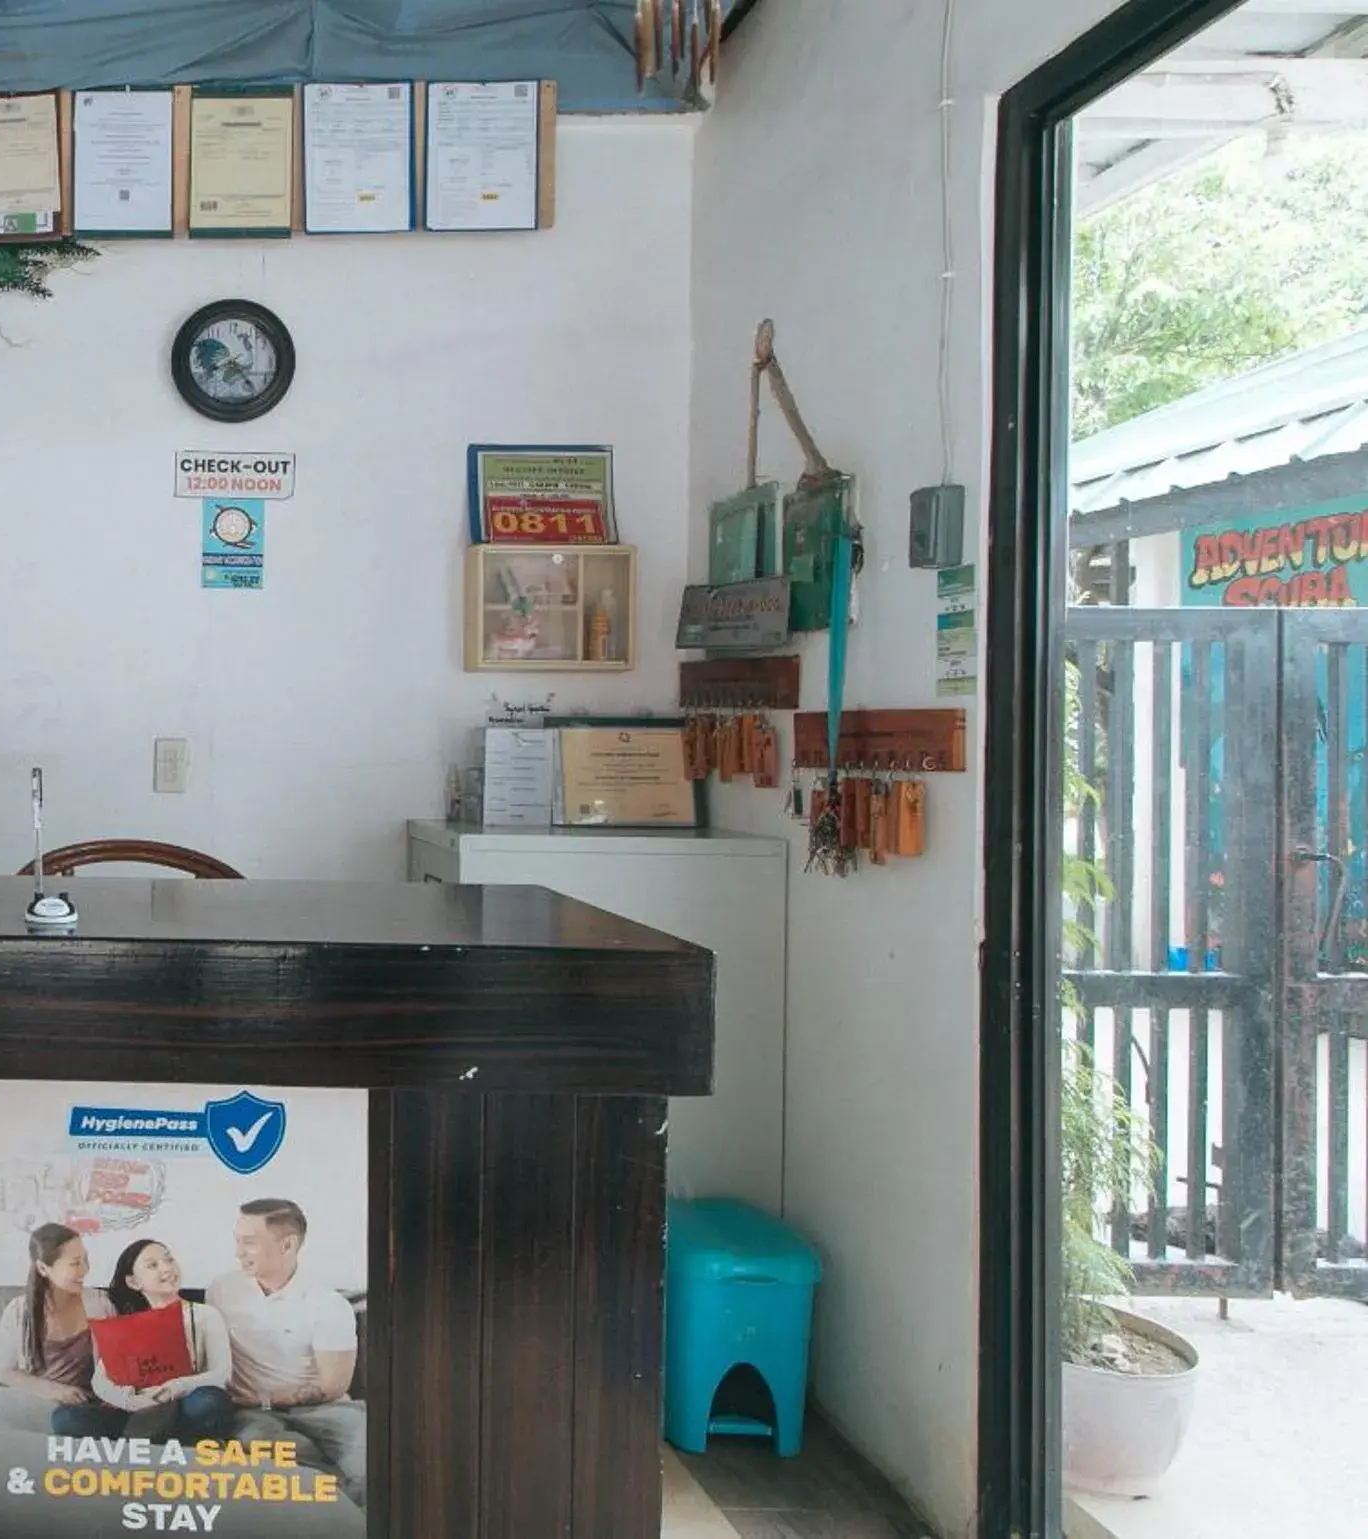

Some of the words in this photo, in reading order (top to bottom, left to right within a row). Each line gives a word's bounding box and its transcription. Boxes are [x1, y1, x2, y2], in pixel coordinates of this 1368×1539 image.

[180, 458, 291, 474] CHECK-OUT
[187, 476, 229, 490] 12:00
[231, 478, 282, 491] NOON
[493, 512, 596, 534] 0811
[1222, 565, 1358, 607] SCUBA
[81, 1115, 199, 1131] HygienePass
[77, 1141, 139, 1151] OFFICIALLY
[141, 1142, 201, 1152] CERTIFIED
[47, 1436, 151, 1465] HAVE
[159, 1438, 188, 1466] A
[195, 1439, 297, 1469] SAFE
[6, 1467, 36, 1496] &
[43, 1467, 339, 1503] COMFORTABLE
[121, 1503, 222, 1533] STAY
